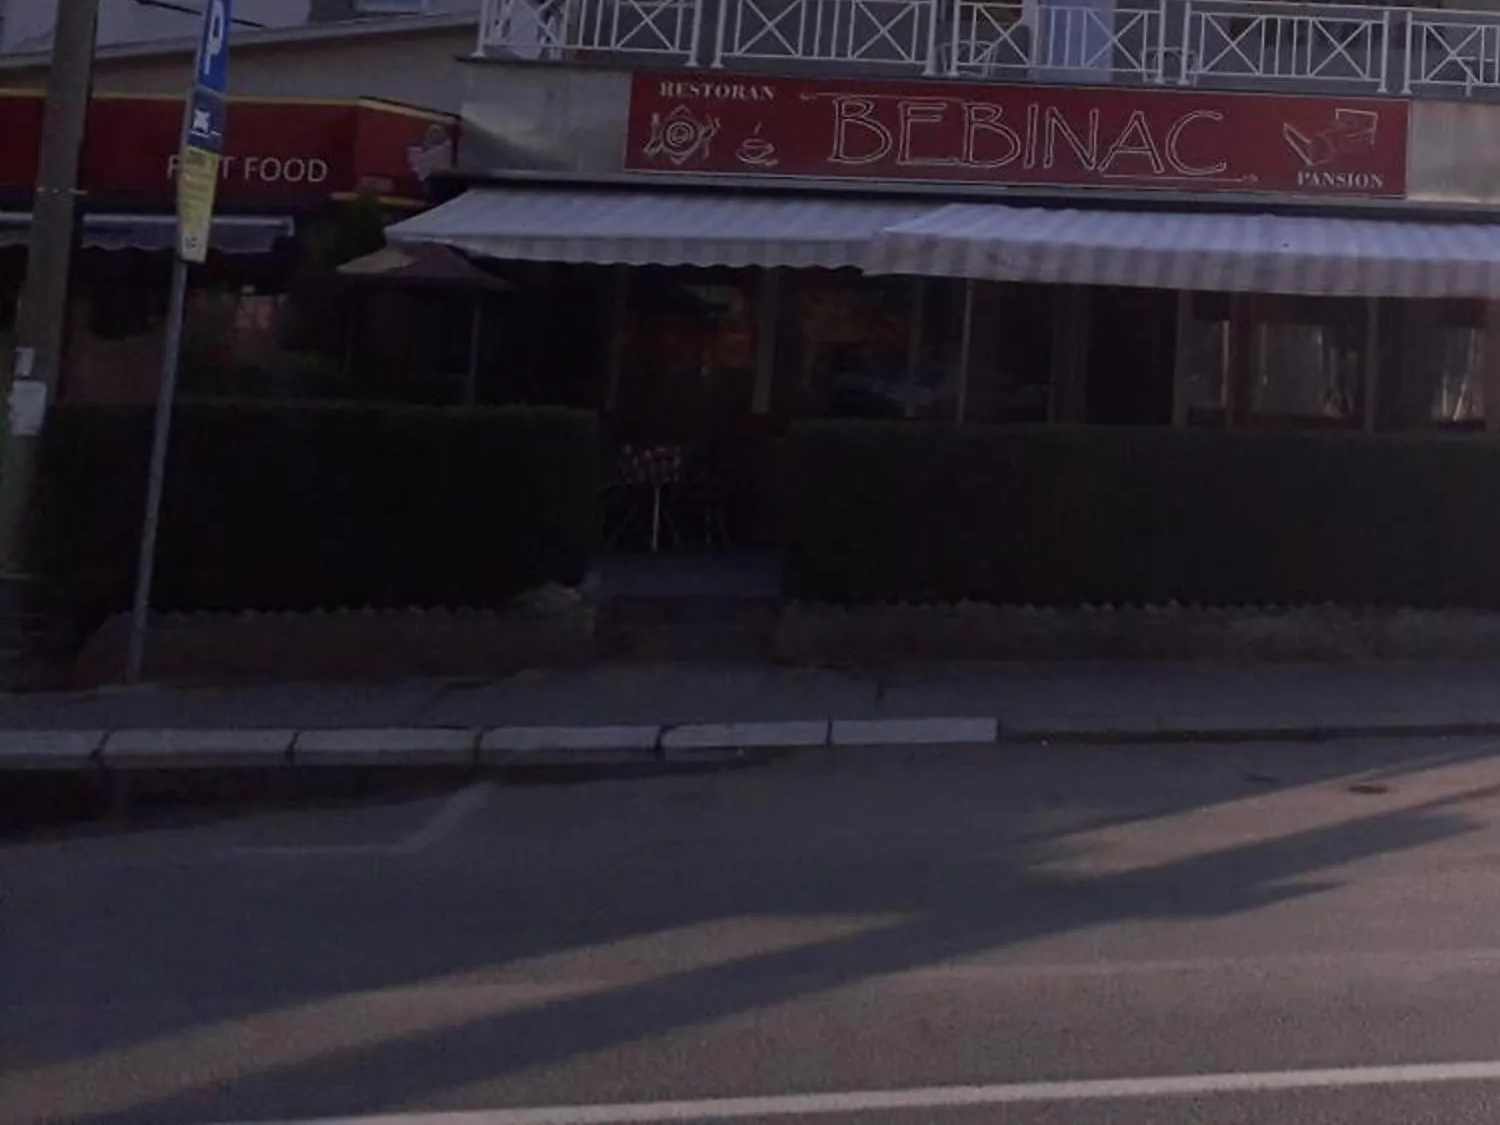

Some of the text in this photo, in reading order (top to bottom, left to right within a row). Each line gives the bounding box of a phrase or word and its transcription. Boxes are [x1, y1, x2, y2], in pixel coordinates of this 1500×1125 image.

[659, 81, 775, 101] RESTORAN
[828, 95, 1227, 175] BEBINAC
[167, 154, 235, 181] FT
[245, 157, 328, 183] FOOD
[1298, 170, 1383, 189] PANSION
